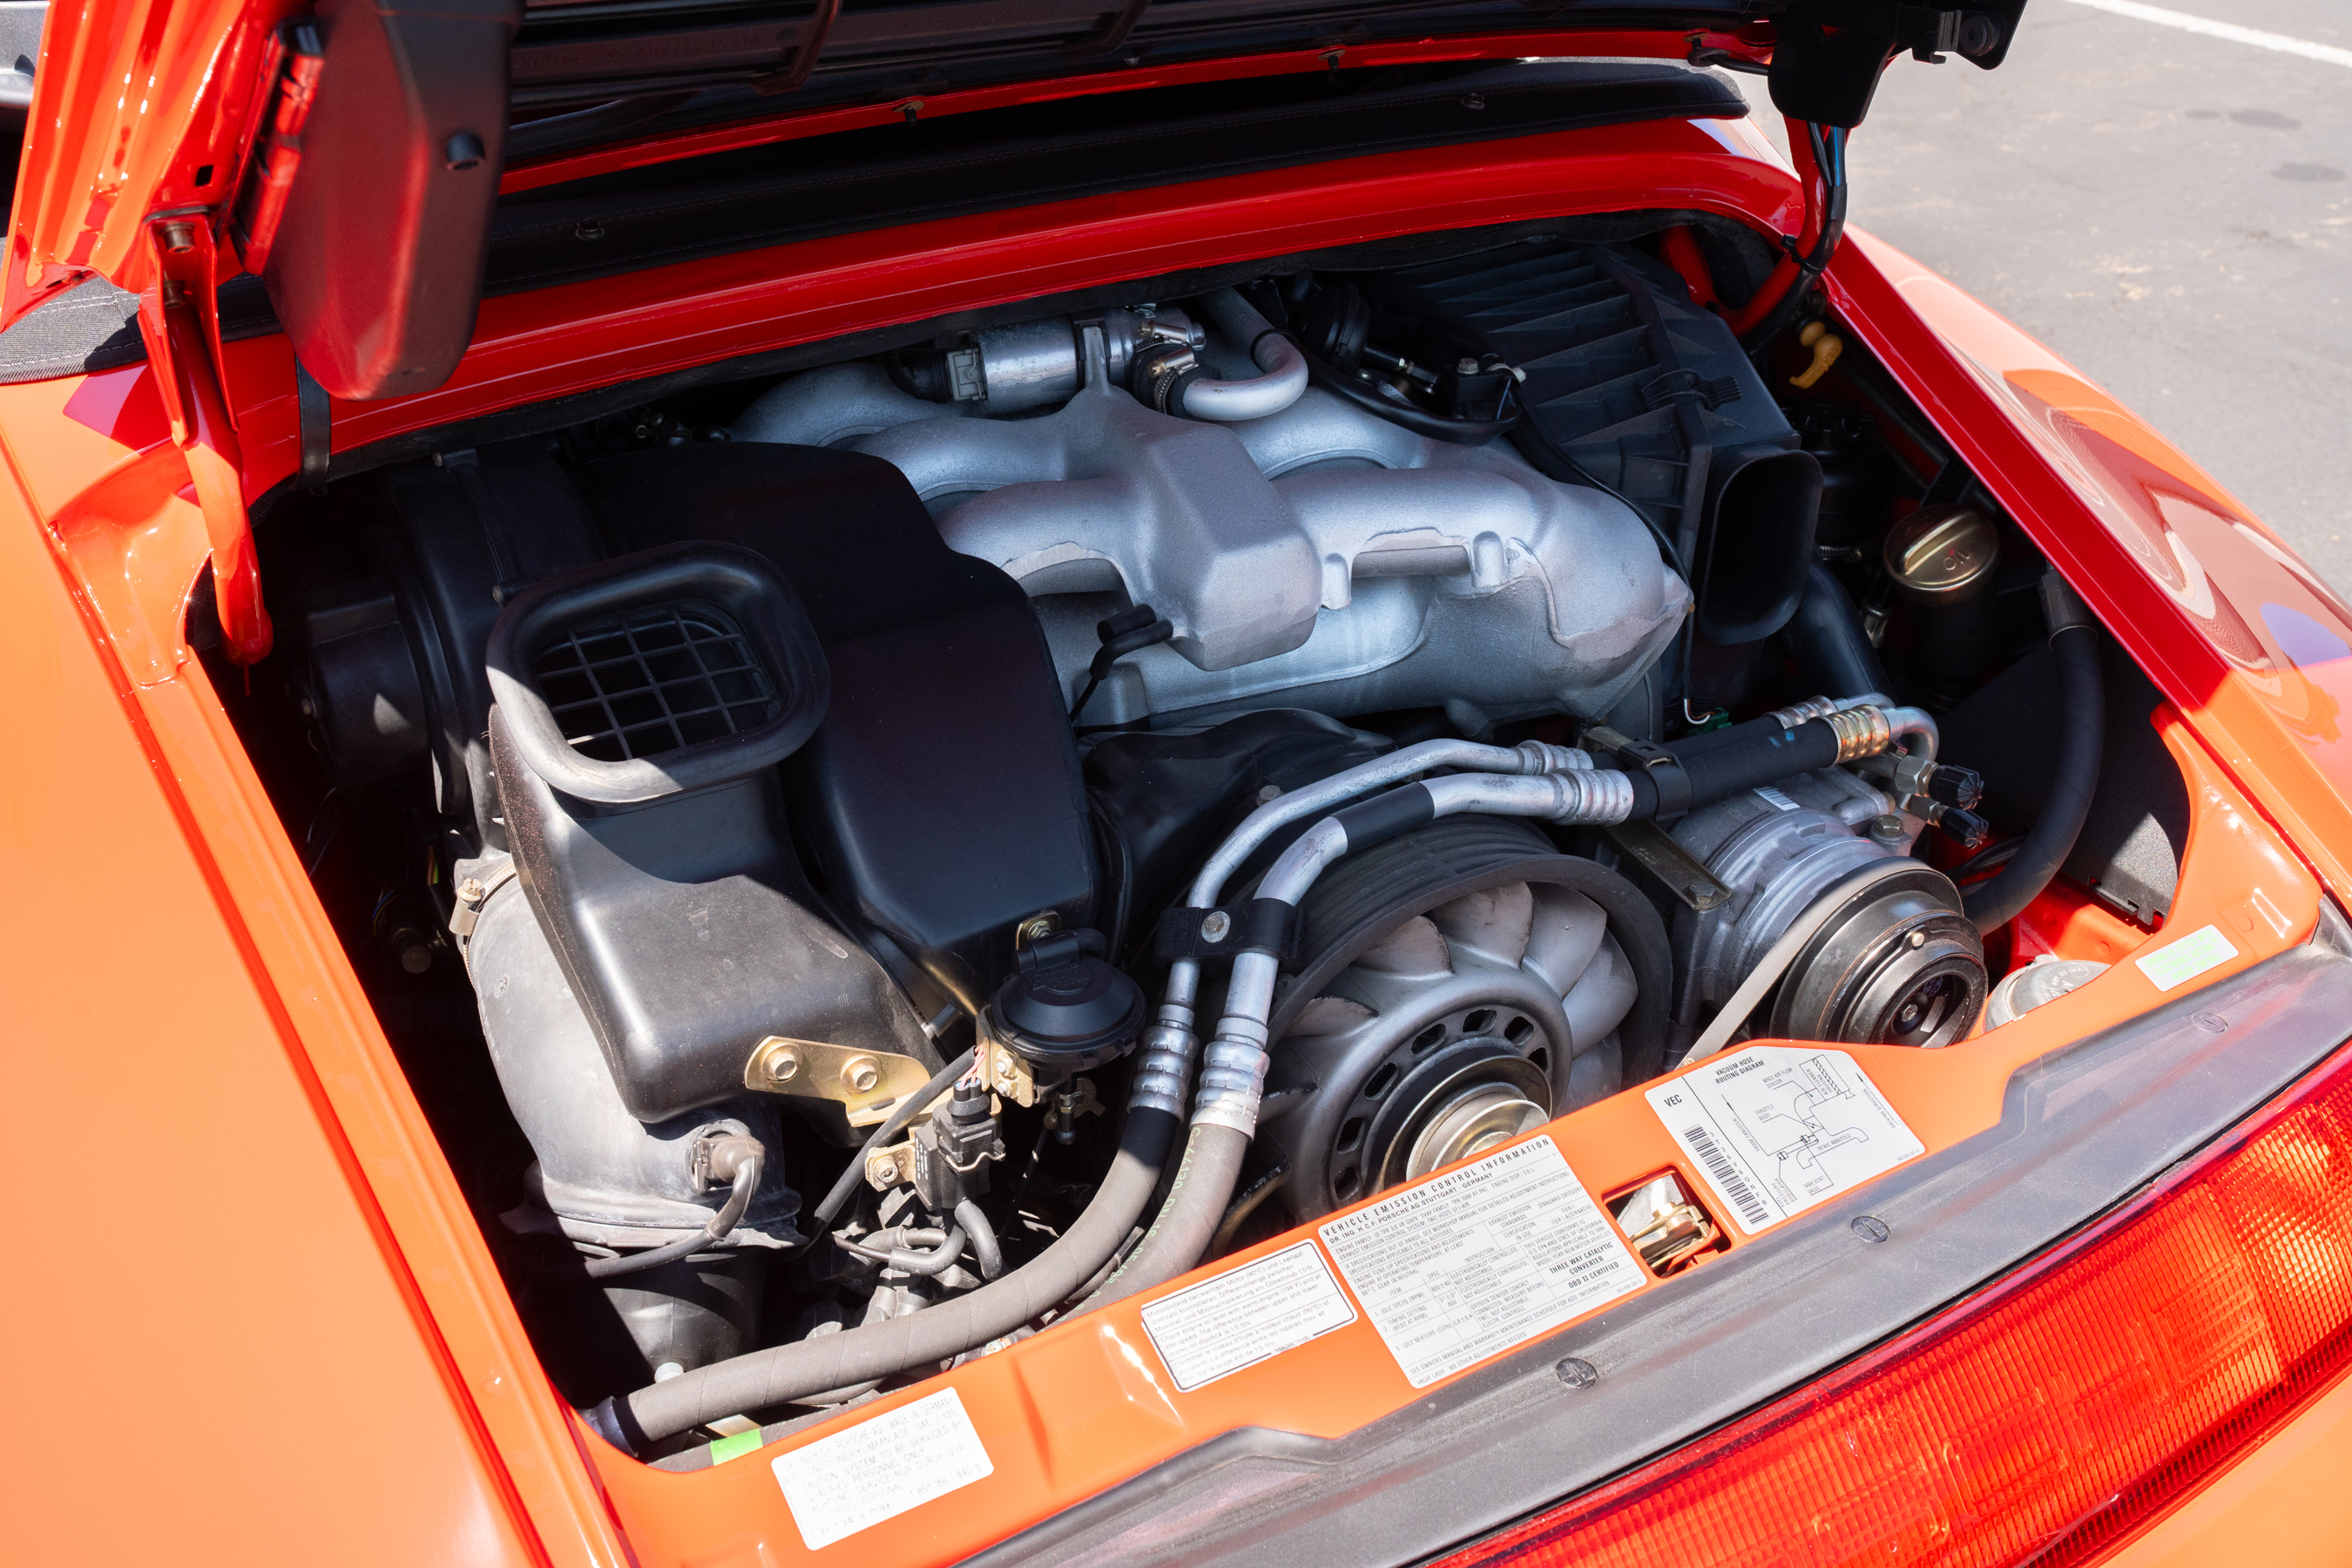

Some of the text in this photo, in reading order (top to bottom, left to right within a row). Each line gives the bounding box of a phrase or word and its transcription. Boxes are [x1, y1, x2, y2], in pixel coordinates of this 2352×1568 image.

[1943, 550, 1973, 571] OIL
[1714, 1056, 1754, 1076] VACUUM HOSE
[1714, 1059, 1765, 1085] ROUTING DIAGRAM
[1806, 1068, 1822, 1087] CLEANER
[1766, 1078, 1784, 1089] SENSOR
[1816, 1073, 1834, 1093] HOUSING
[1663, 1094, 1683, 1107] VEC
[1754, 1104, 1775, 1115] THROTTLE
[1862, 1087, 1896, 1129] DRIVING DIRECTION
[1758, 1112, 1771, 1121] BODY
[1732, 1118, 1761, 1152] FROM CANISTER
[1816, 1133, 1852, 1151] INTAKE MANIFOLD
[1323, 1139, 1550, 1236] VEHICLE EMISSION CONTROL INFORMATION
[1538, 1186, 1583, 1208] STANDARD CATEGORY
[1771, 1182, 1790, 1206] PRESSURE
[1774, 1177, 1795, 1203] REGULATOR
[1807, 1185, 1821, 1194] VALVE
[1329, 1235, 1341, 1244] DR.
[1342, 1227, 1357, 1239] ING.
[1377, 1206, 1409, 1224] PORSCHE
[1421, 1186, 1457, 1206] STUTTGART
[1462, 1172, 1493, 1188] GERMANY
[1775, 1196, 1786, 1207] FUEL
[1350, 1247, 1388, 1267] SPECIFICATIONS
[1387, 1243, 1398, 1252] OUT
[1422, 1228, 1432, 1237] SEE
[1431, 1218, 1458, 1233] WORKSHOP
[1457, 1210, 1478, 1221] MANUAL
[1488, 1196, 1510, 1209] DETAILED
[1509, 1184, 1538, 1200] ADJUSTMENT
[1538, 1171, 1570, 1187] INSTRUCTIONS
[1488, 1204, 1532, 1227] EXHAUST EMISSION
[1500, 1213, 1528, 1228] STANDARDS
[1503, 1221, 1537, 1239] CERTIFICATION
[1515, 1230, 1532, 1241] IN-USE
[1524, 1240, 1536, 1249] THIS
[1534, 1233, 1554, 1244] VEHICLE
[1553, 1221, 1579, 1236] CONFORMS
[1557, 1233, 1571, 1242] STATE
[1577, 1219, 1603, 1233] CALIFORNIA
[1339, 1228, 1407, 1260] EXHAUST EMISSION CONTROL
[1348, 1256, 1386, 1276] SPECIFICATIONS
[1386, 1245, 1413, 1260] APPLICABLE
[1429, 1227, 1454, 1241] ALTITUDES
[1463, 1247, 1495, 1263] INSTRUCTION
[1536, 1256, 1553, 1267] MODEL
[1552, 1251, 1565, 1260] YEAR
[1574, 1239, 1592, 1249] MOTOR
[1353, 1273, 1372, 1284] ENGINE
[1372, 1263, 1394, 1275] TUNE-UP
[1394, 1247, 1431, 1267] SPECIFICATIONS
[1441, 1228, 1475, 1246] ADJUSTMENTS
[1356, 1279, 1376, 1290] ENGINE
[1382, 1264, 1409, 1279] OPERATING
[1450, 1240, 1464, 1250] LEAST
[1549, 1241, 1613, 1274] THREE WAY CATALYTIC
[1569, 1255, 1605, 1275] CONVERTER
[1427, 1270, 1441, 1280] SPEC
[1450, 1260, 1488, 1280] ELECTRONICALLY
[1454, 1265, 1493, 1286] NOT ADJUSTABLE
[1568, 1278, 1582, 1288] OBD
[1589, 1261, 1619, 1279] CERTIFIED
[1389, 1287, 1402, 1295] ITEM
[1470, 1280, 1530, 1310] OXYGEN SENSOR CONTACT
[1380, 1292, 1425, 1315] IDLE SPEED (RPM)
[1409, 1281, 1610, 1375] SEE OWNERS MANUAL AND WARRANTY-MAINTENANCE SCHEDULE FOR INFORMATION
[1456, 1355, 1474, 1367] OTHER
[1473, 1340, 1508, 1359] ADJUSTMENTS
[1506, 1331, 1527, 1343] NEEDED
